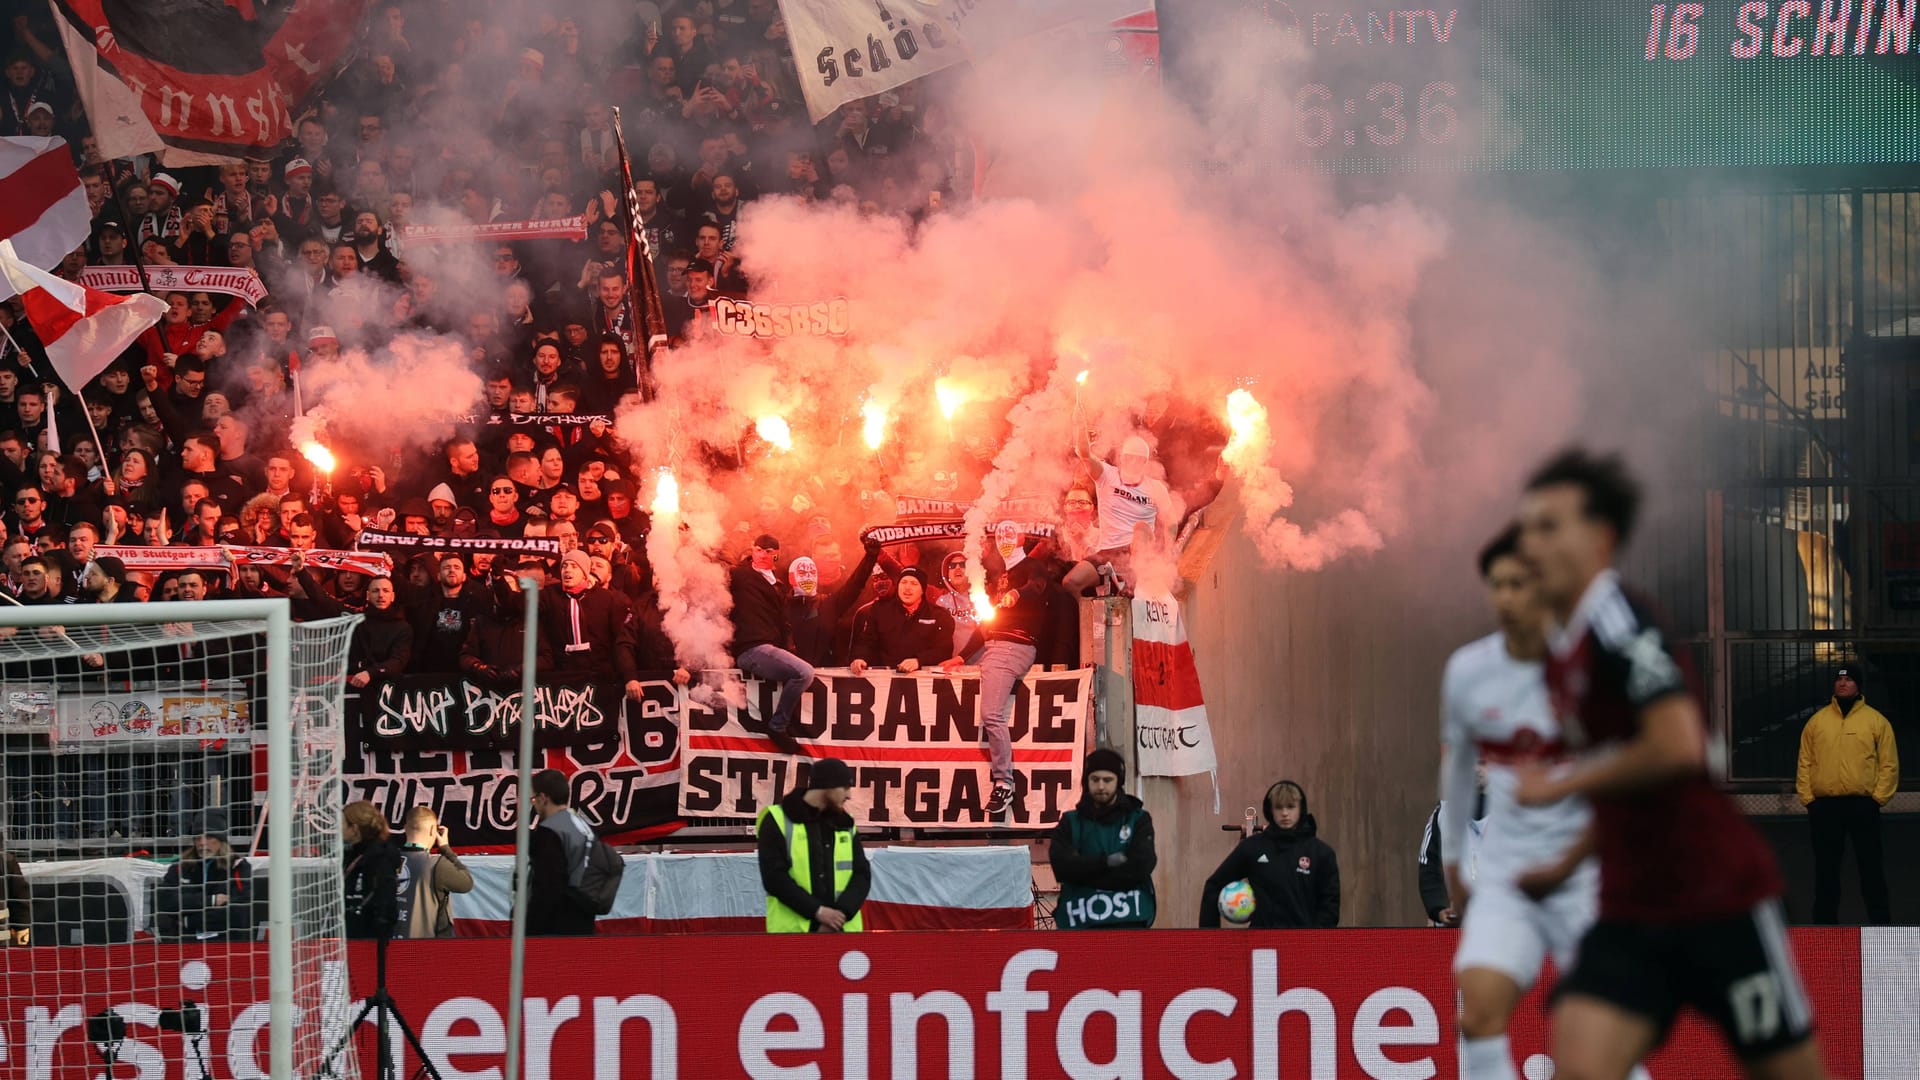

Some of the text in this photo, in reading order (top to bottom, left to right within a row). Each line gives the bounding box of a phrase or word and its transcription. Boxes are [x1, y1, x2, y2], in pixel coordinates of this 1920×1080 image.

[1312, 9, 1457, 45] FANTV
[1645, 0, 1920, 60] 16 SCHIN
[528, 216, 583, 229] KURVE
[115, 550, 196, 561] VfB Stuttgart
[360, 532, 419, 546] CREW
[450, 538, 560, 553] STUTTGART
[310, 768, 648, 832] STUTTGRT
[685, 756, 1073, 824] STTGART
[1066, 890, 1141, 928] HOST
[0, 960, 679, 1080] rsichern
